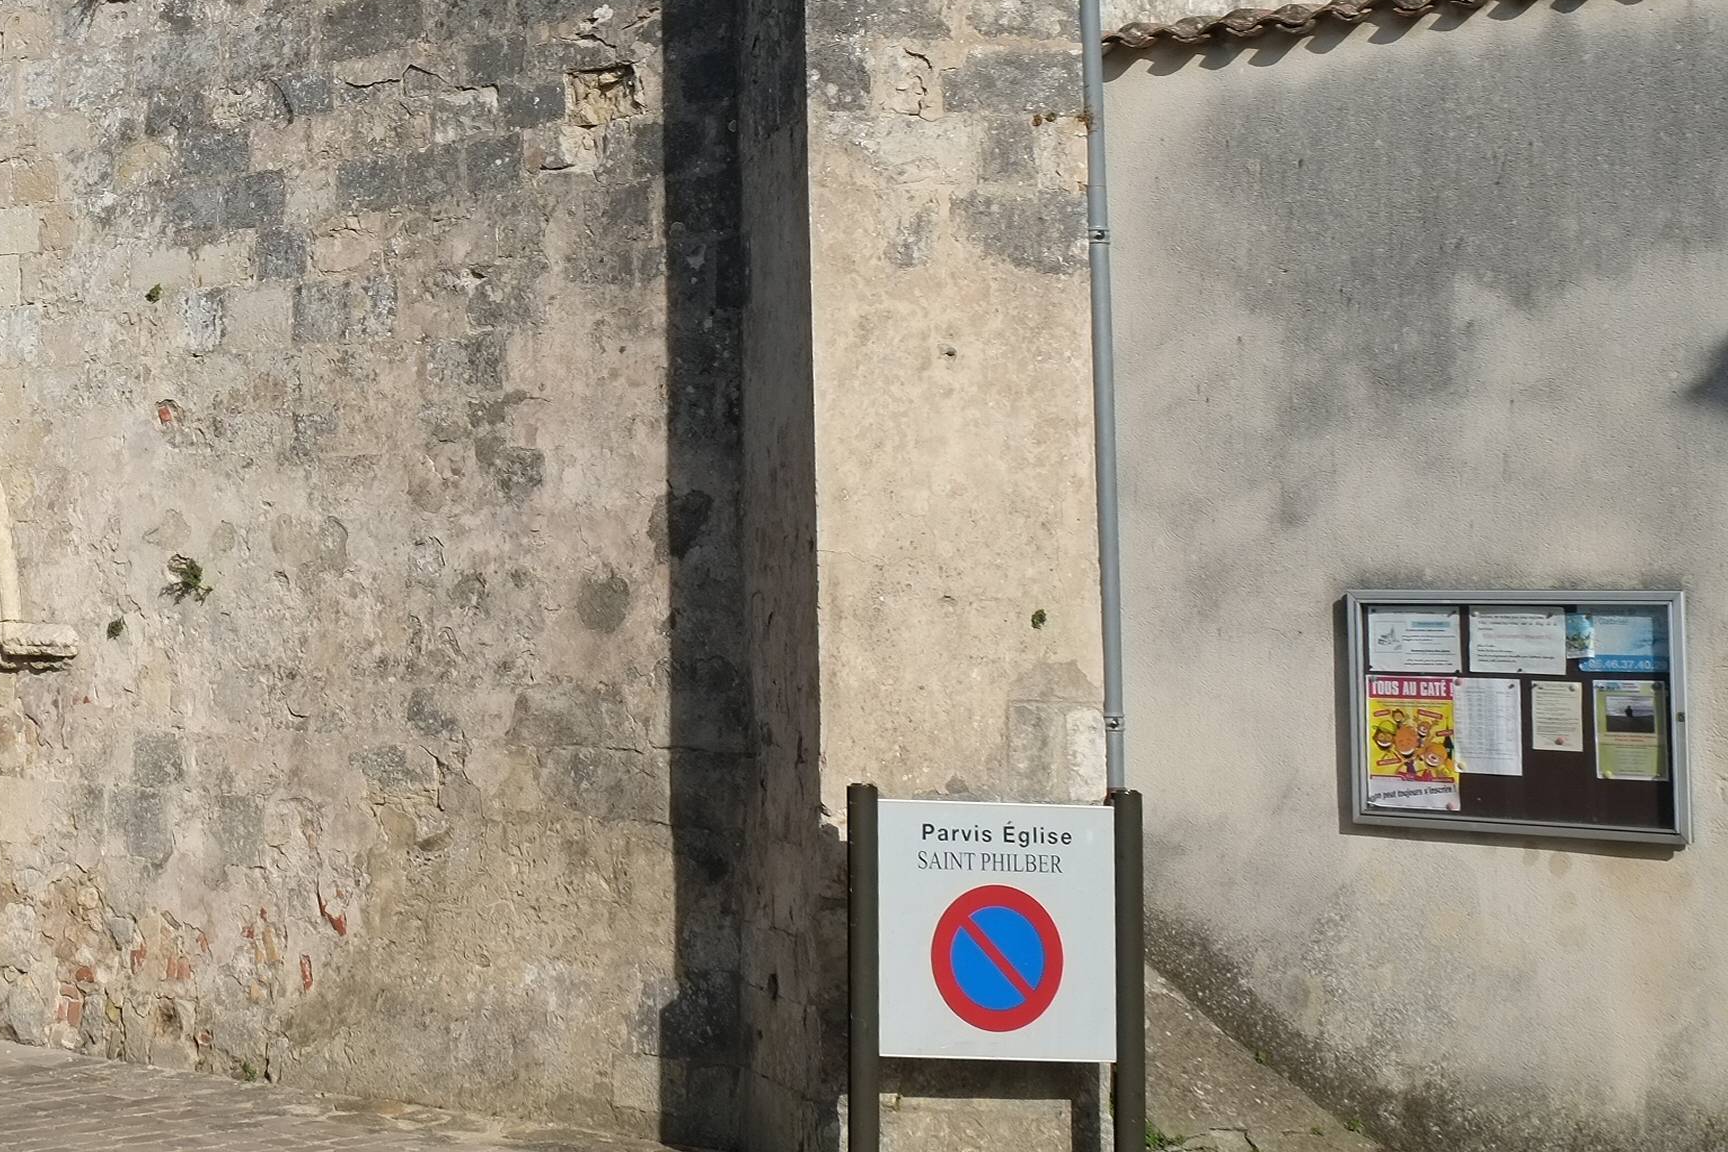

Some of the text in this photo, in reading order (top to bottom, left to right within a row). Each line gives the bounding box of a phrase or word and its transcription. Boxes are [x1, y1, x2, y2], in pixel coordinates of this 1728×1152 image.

[1372, 680, 1399, 695] TOUS
[1402, 681, 1417, 696] AU
[1420, 679, 1447, 697] CATÉ
[922, 820, 1072, 848] Parvis Église
[917, 850, 1063, 874] SAINT PHILBER
